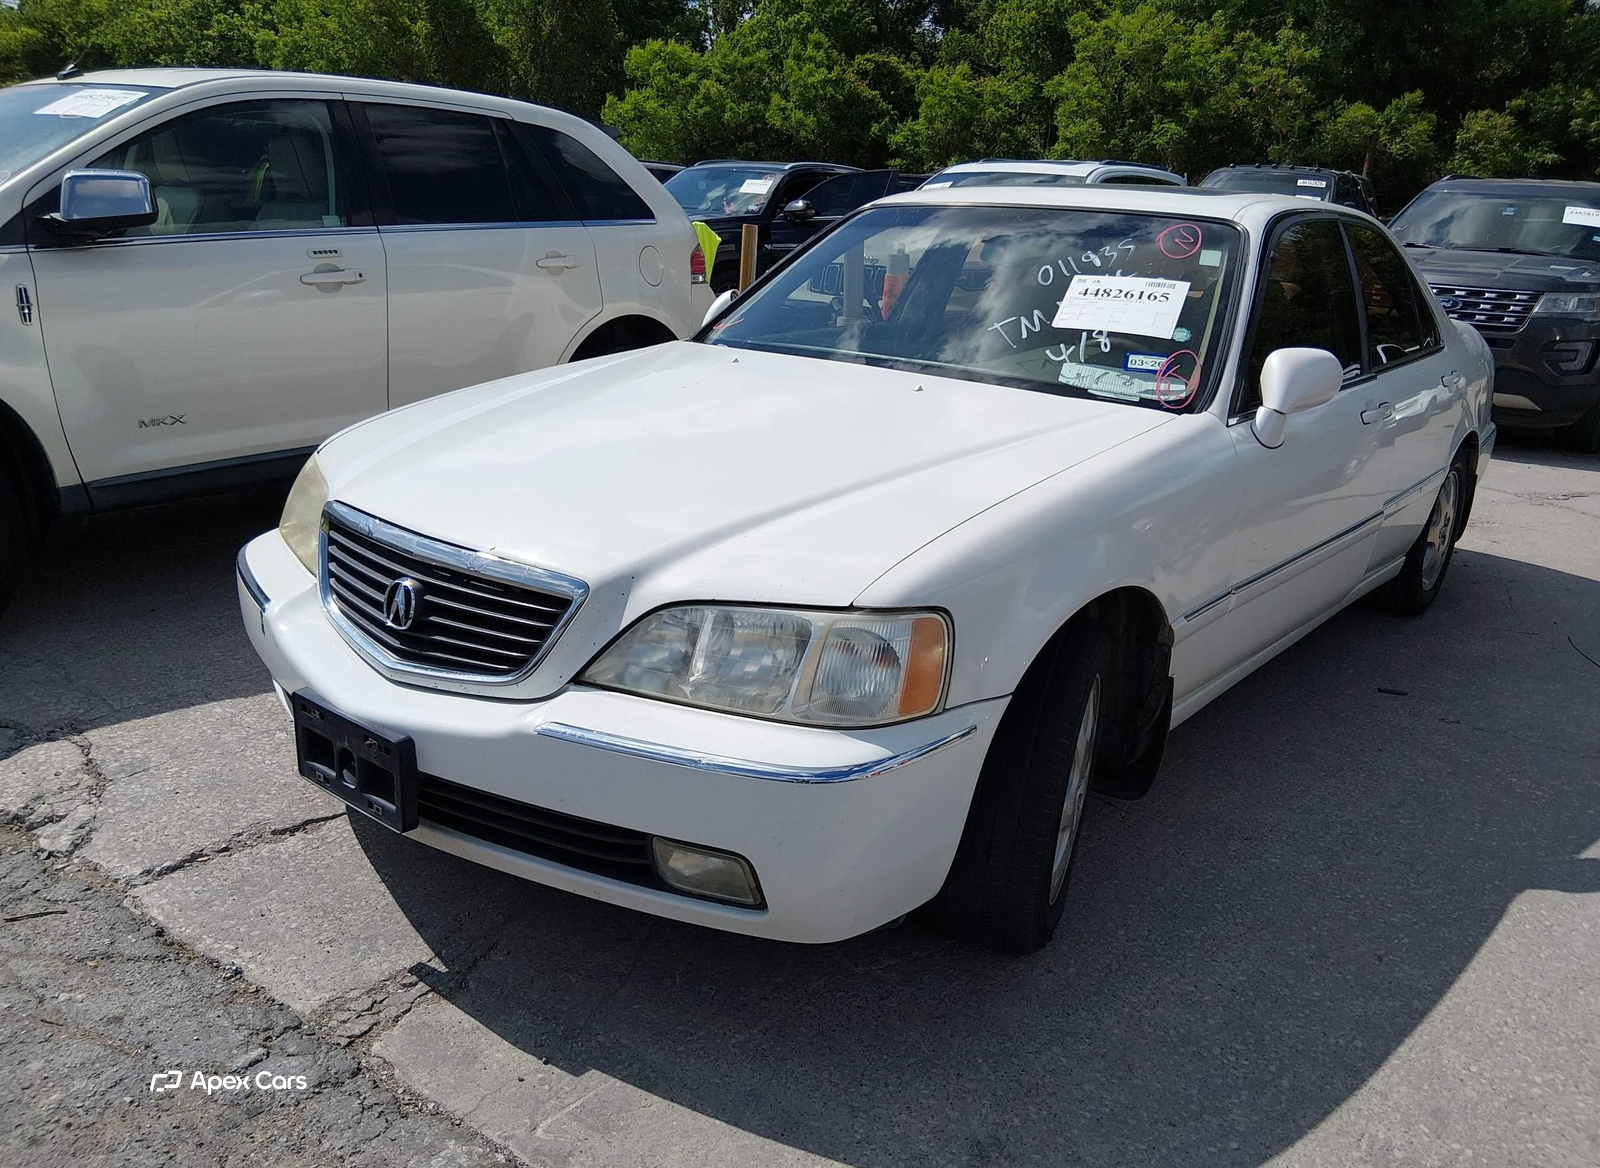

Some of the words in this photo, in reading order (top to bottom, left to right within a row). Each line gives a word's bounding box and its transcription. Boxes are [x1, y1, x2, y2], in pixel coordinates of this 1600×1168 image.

[1078, 287, 1171, 303] 44826165
[987, 300, 1063, 349] TM
[1130, 358, 1145, 367] 03
[138, 413, 188, 429] MKX
